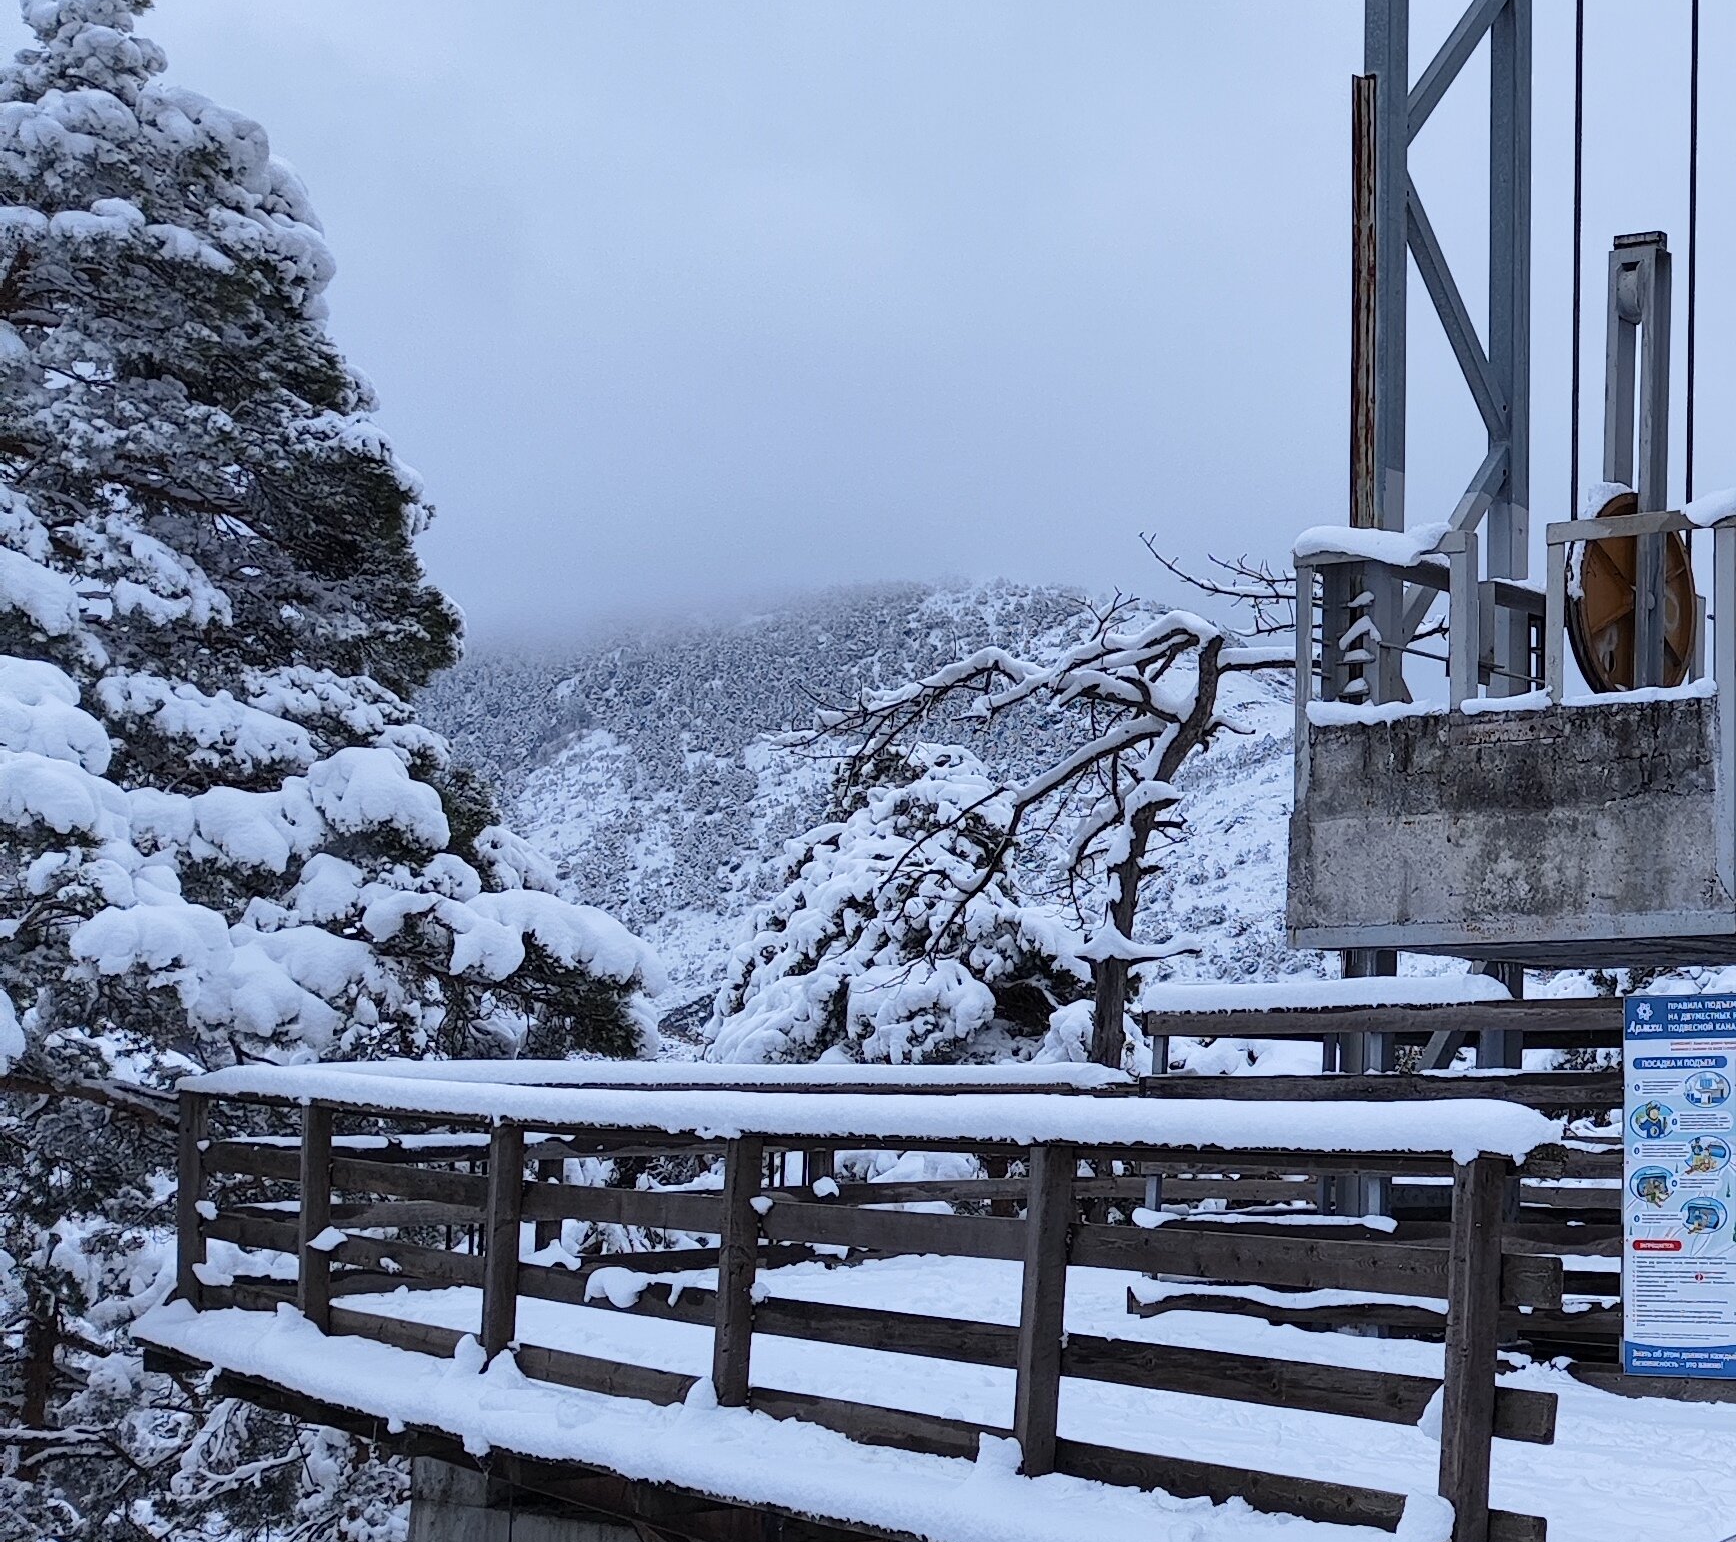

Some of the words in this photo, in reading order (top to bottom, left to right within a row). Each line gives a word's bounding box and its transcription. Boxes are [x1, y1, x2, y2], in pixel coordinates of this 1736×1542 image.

[1668, 1001, 1703, 1010] ПРАВИЛА
[1668, 1013, 1679, 1021] НА
[1680, 1011, 1730, 1022] ДВУМЕСТНЫХ
[1668, 1021, 1713, 1033] ПОДВЕСНОЙ
[1641, 1059, 1677, 1068] ПОСАДКА
